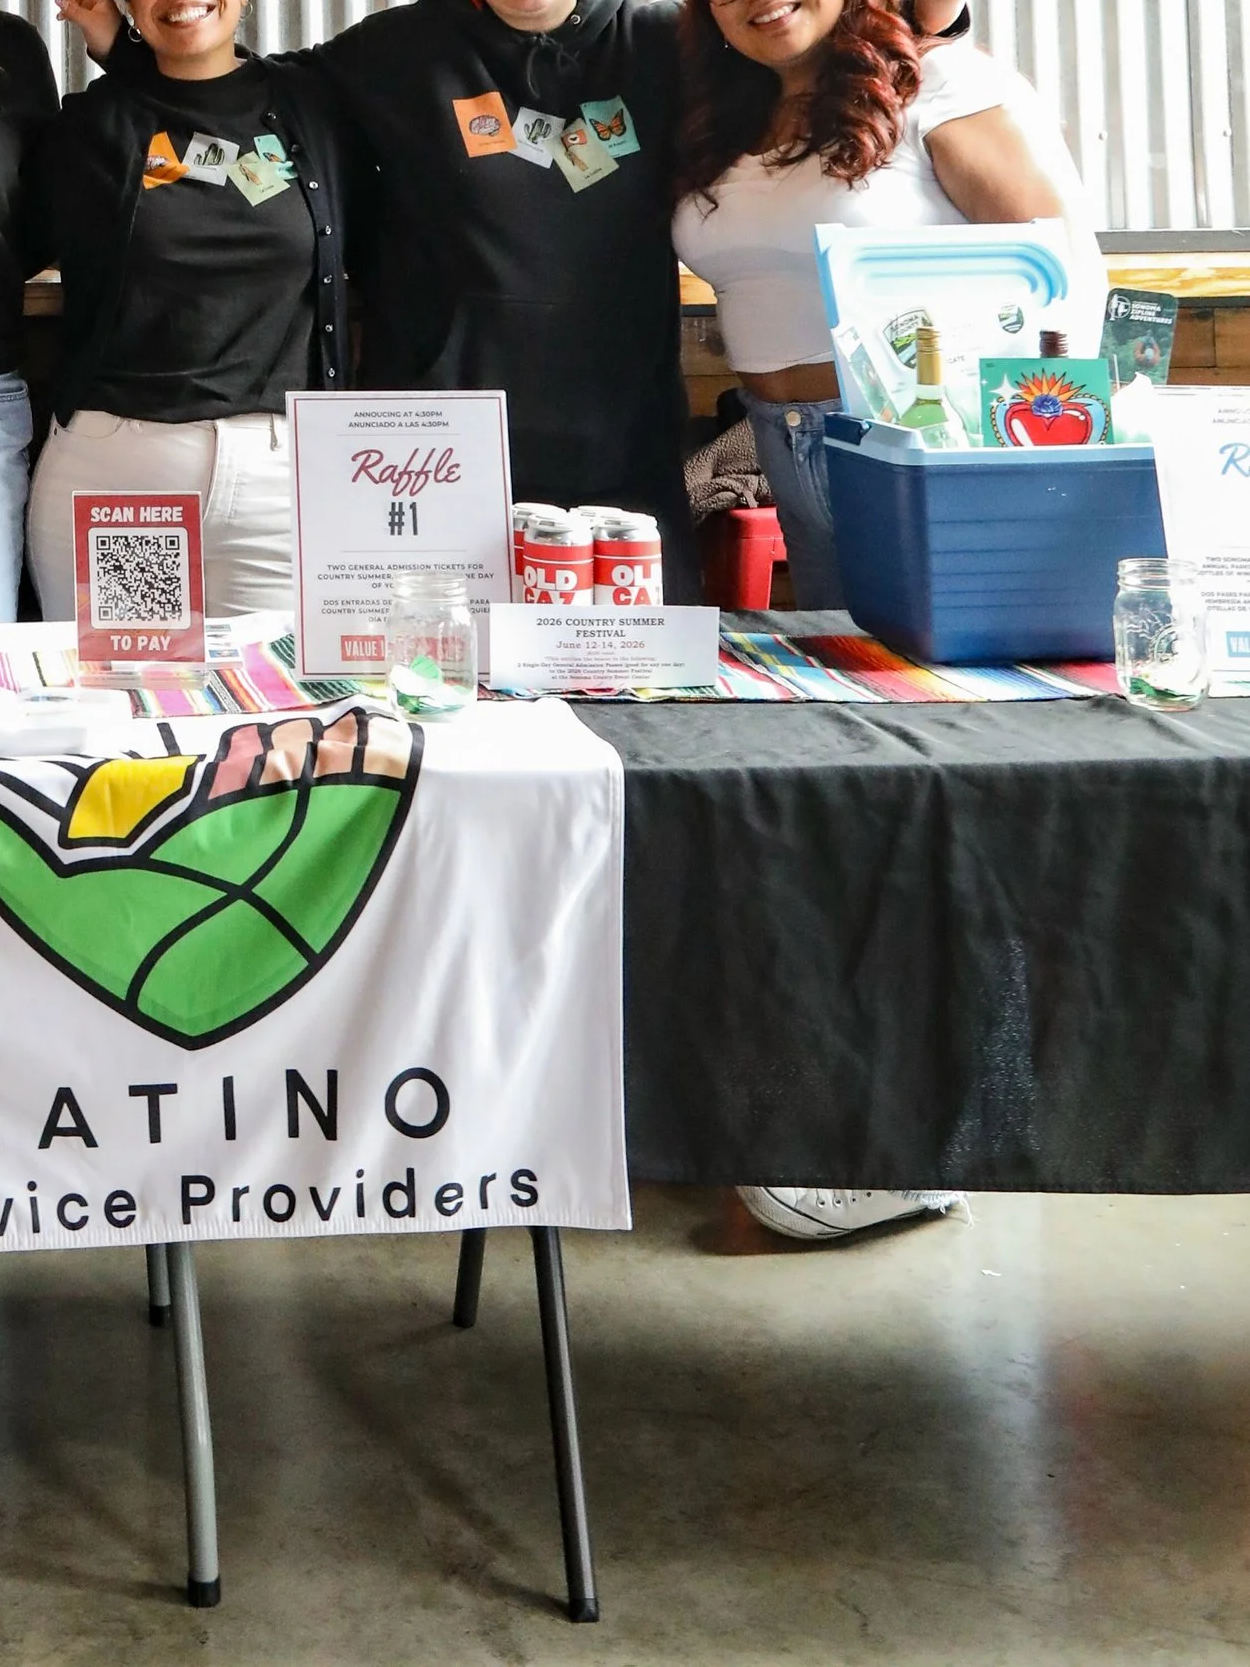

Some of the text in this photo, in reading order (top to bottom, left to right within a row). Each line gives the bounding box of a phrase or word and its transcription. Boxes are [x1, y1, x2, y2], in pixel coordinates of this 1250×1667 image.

[1132, 303, 1162, 312] SONOMA
[351, 447, 462, 497] Raffle
[90, 506, 183, 522] SCAN HERE
[388, 502, 418, 536] #1
[524, 565, 578, 590] OLD
[612, 565, 662, 586] OL
[612, 586, 652, 605] CA
[536, 618, 664, 626] 2026 COUNTRY SUMMER
[110, 636, 171, 651] TO PAY
[345, 640, 377, 656] VALUE
[556, 641, 645, 650] June 12-14, 2026
[181, 1167, 540, 1225] Providers
